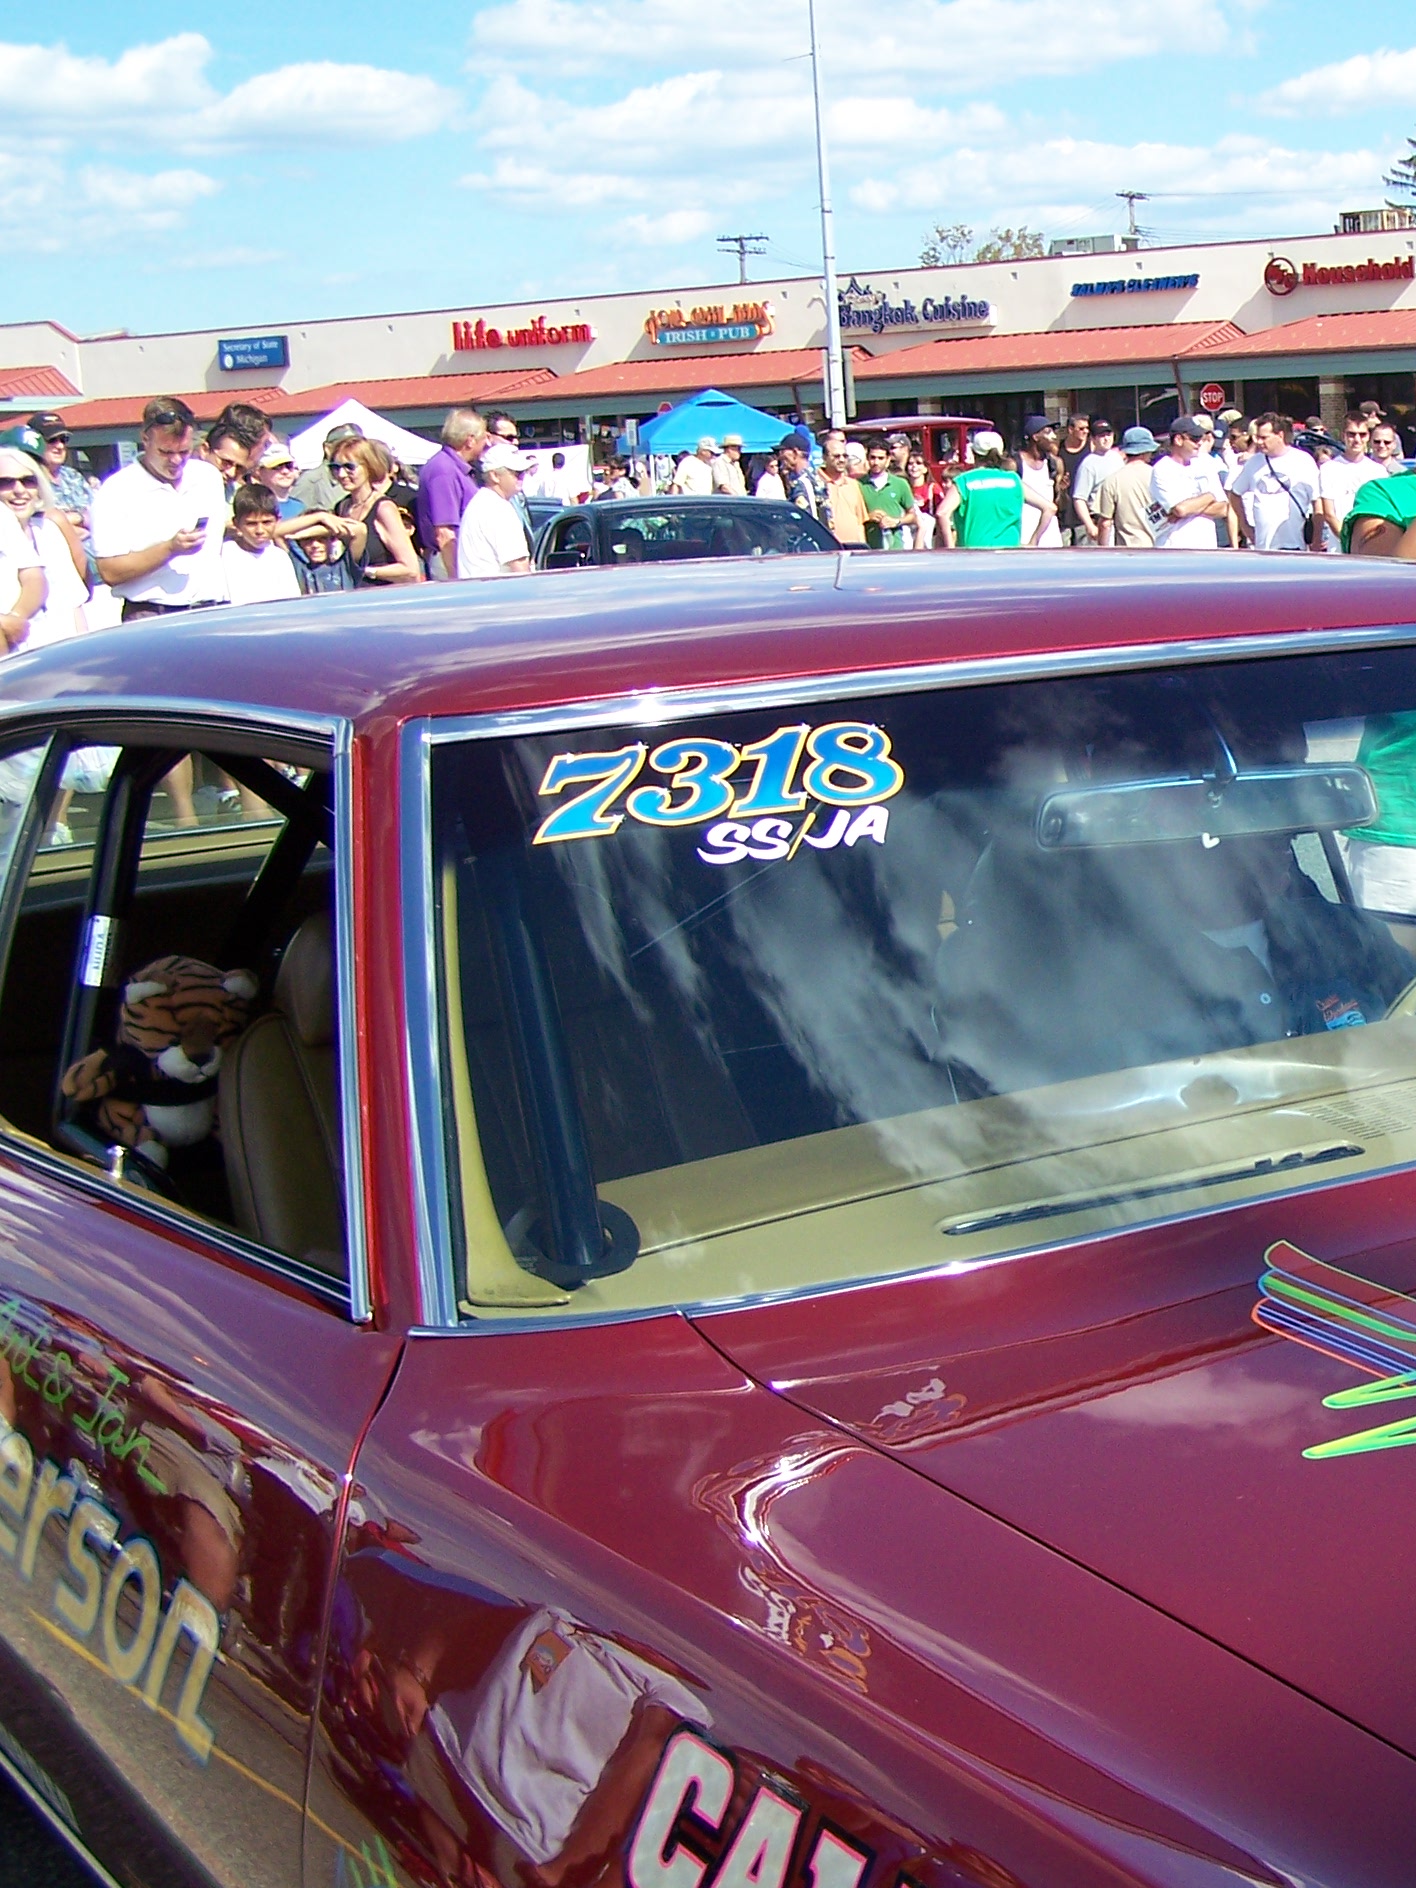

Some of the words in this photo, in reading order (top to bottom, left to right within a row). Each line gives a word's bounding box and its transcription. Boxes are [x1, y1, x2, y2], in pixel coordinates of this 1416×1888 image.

[1302, 255, 1415, 286] Household
[838, 299, 919, 333] Bangkok
[922, 294, 990, 322] Cuisine
[452, 318, 502, 350] life
[506, 315, 593, 347] uniform
[664, 330, 706, 344] IRISH
[718, 326, 750, 340] PUB
[1203, 391, 1223, 403] STOP
[532, 721, 905, 846] 7318
[696, 804, 892, 865] SS/JA
